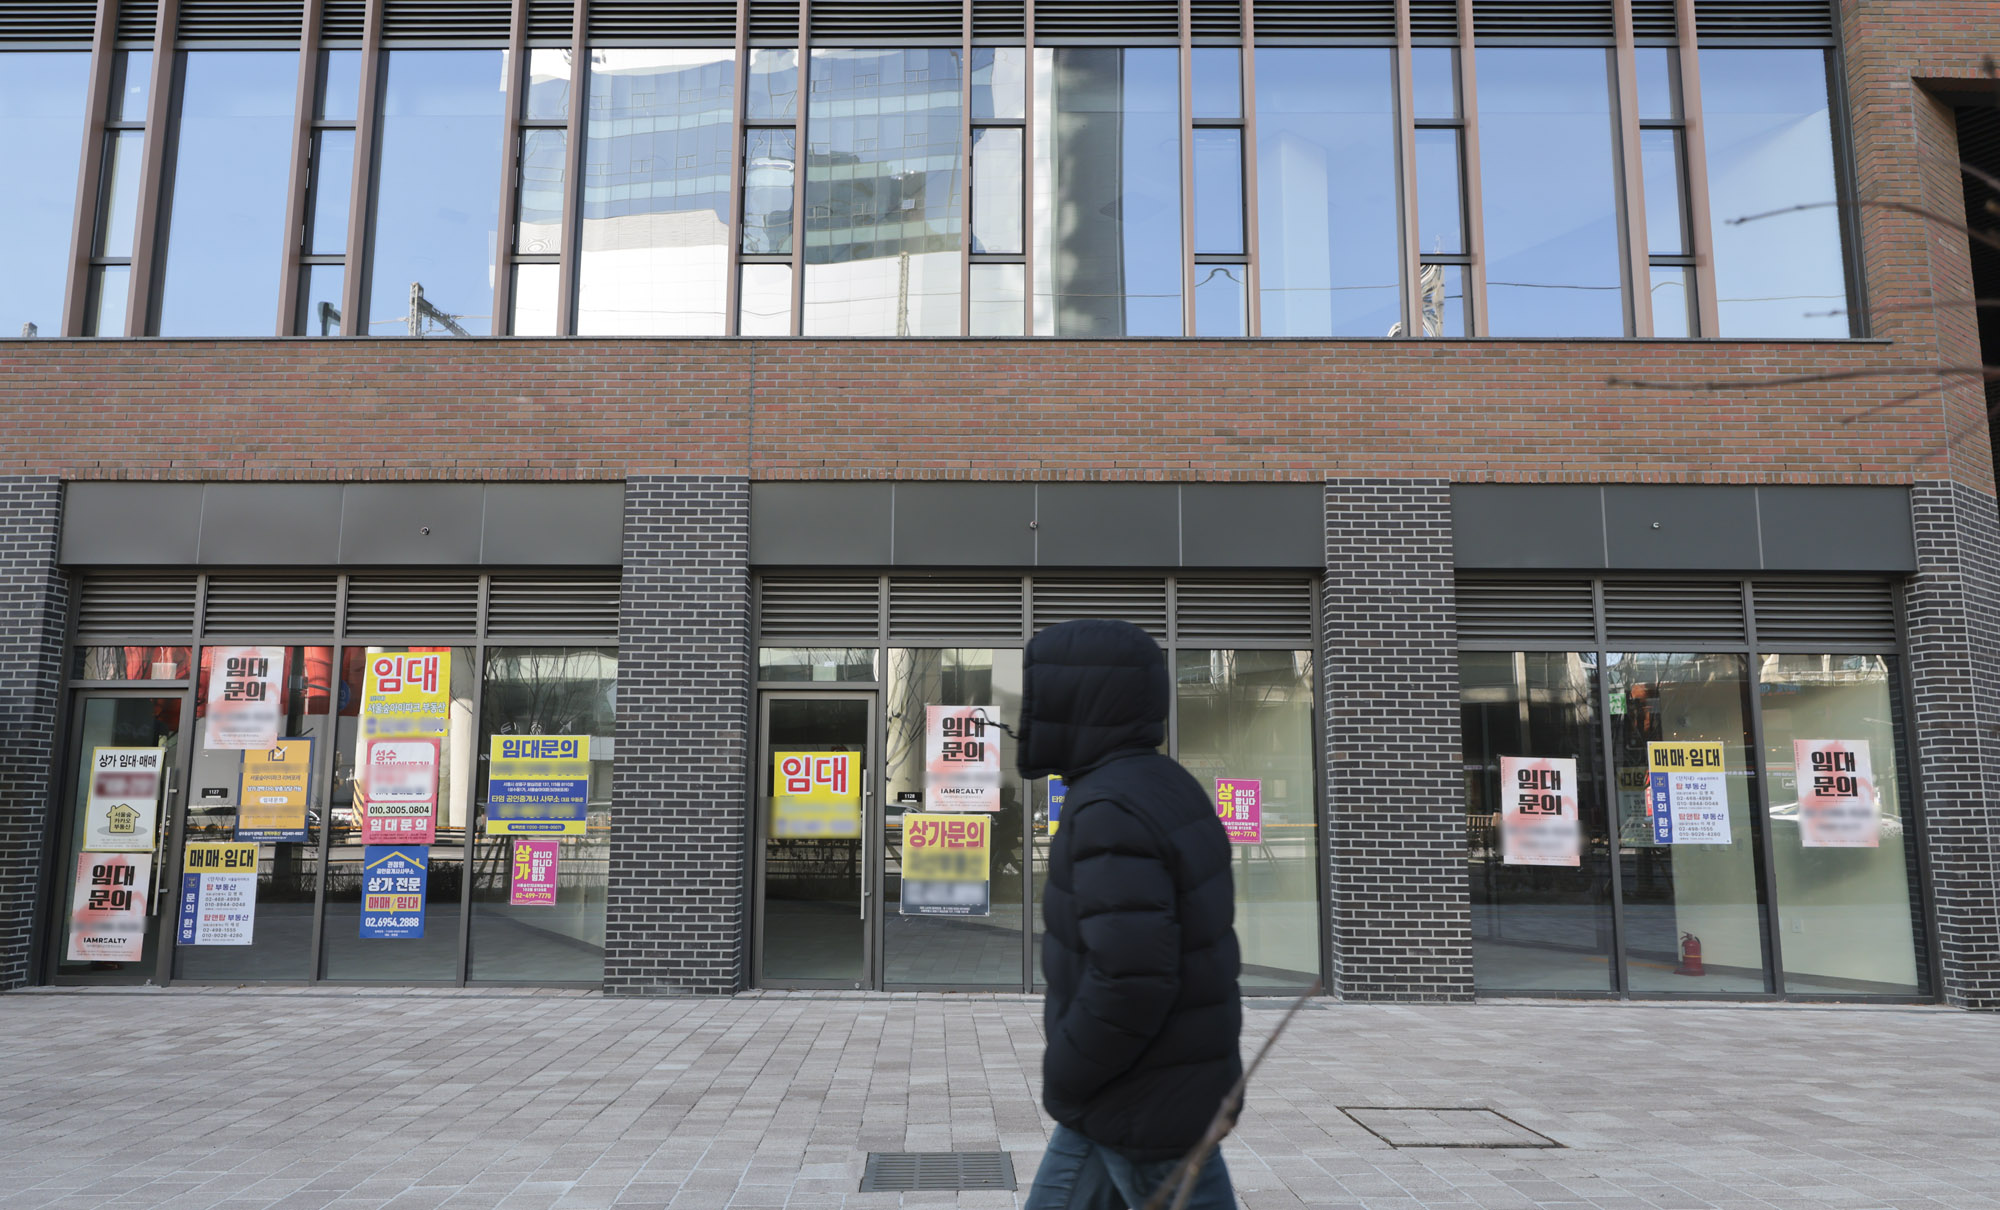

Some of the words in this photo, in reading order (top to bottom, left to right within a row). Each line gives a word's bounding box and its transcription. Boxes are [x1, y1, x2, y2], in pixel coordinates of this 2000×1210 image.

[226, 657, 268, 677] 임대
[374, 656, 438, 692] 임대
[224, 681, 267, 701] 문의
[367, 702, 421, 713] 서울숲아이파크
[422, 702, 446, 714] 부동산
[942, 717, 984, 738] 임대
[376, 750, 396, 761] 성수
[503, 740, 578, 758] 임대문의
[942, 741, 984, 762] 문의
[1654, 749, 1720, 767] 매매·임대
[99, 755, 117, 767] 상가
[120, 755, 157, 768] 임대·매매
[1811, 751, 1856, 772] 임대
[782, 756, 847, 793] 임대
[1518, 769, 1561, 790] 임대
[1235, 789, 1255, 797] 삽니다
[1813, 776, 1858, 797] 문의
[491, 795, 504, 803] 타임
[506, 795, 539, 803] 공인중개사
[540, 795, 559, 803] 사무소
[1218, 783, 1234, 818] 상가
[1518, 794, 1562, 815] 문의
[1656, 792, 1667, 812] 문의
[370, 806, 429, 814] 010.3005.0804
[371, 819, 427, 831] 임대문의
[909, 820, 984, 848] 상가문의
[189, 849, 255, 867] 매매·임대
[515, 845, 532, 880] 상가
[92, 865, 135, 886] 임대
[368, 877, 394, 891] 상가
[396, 877, 421, 891] 전문
[88, 890, 133, 911] 문의
[185, 893, 196, 913] 문의
[365, 917, 419, 927] 02.6954.2888
